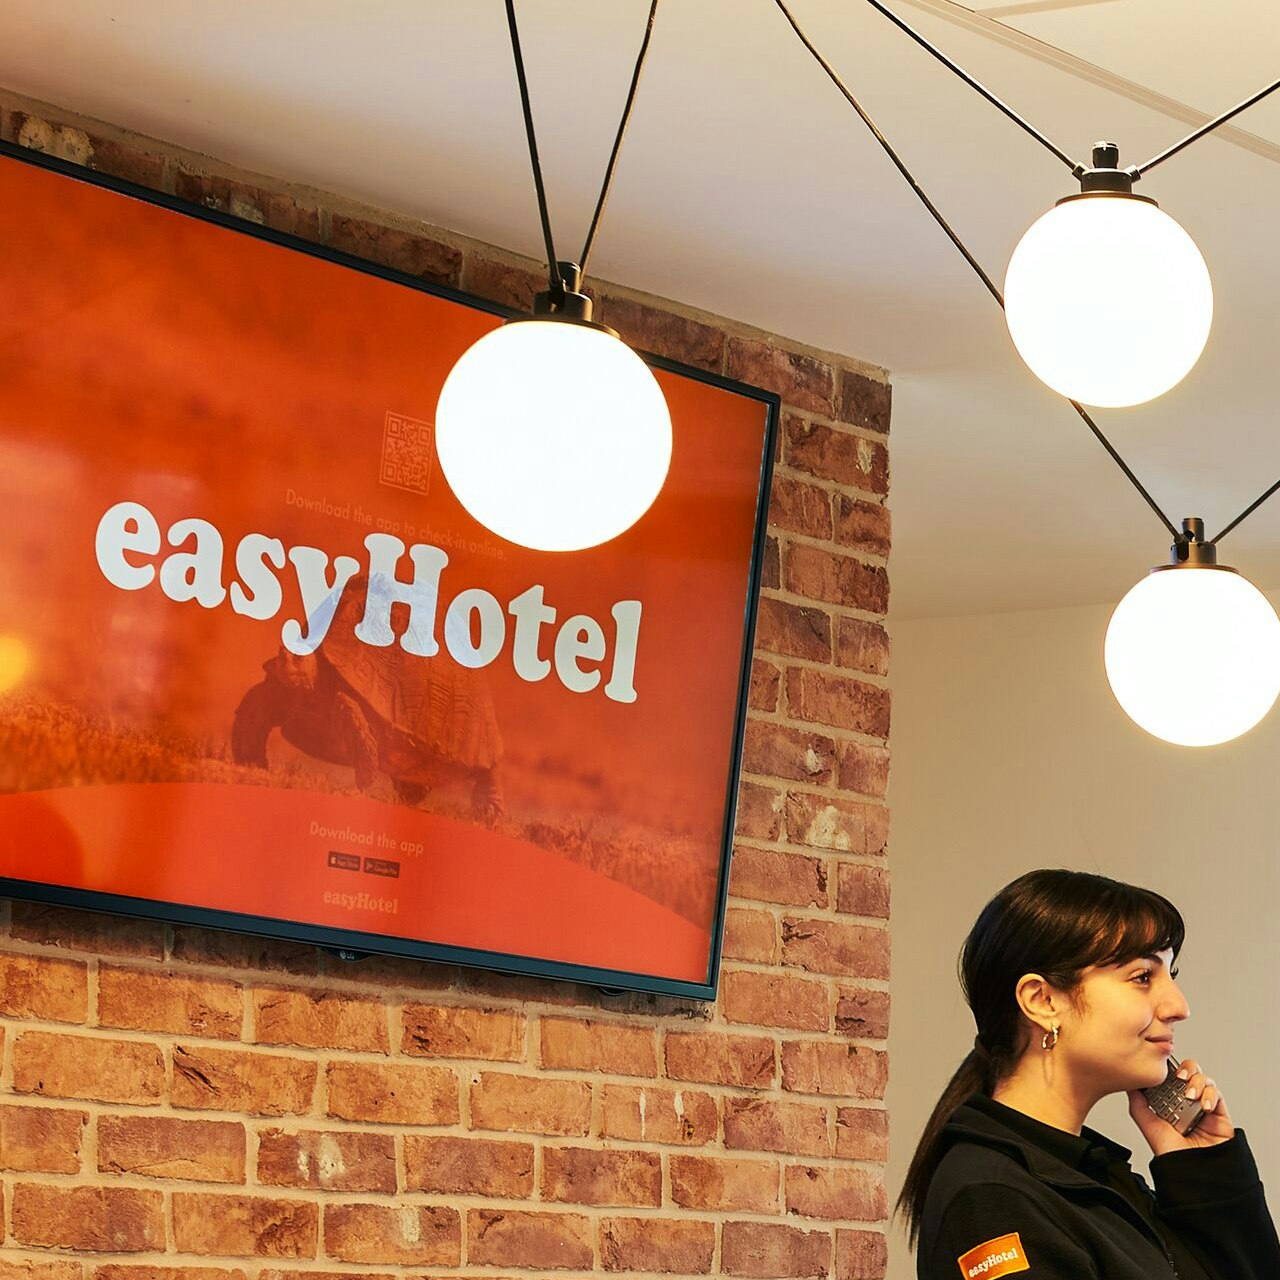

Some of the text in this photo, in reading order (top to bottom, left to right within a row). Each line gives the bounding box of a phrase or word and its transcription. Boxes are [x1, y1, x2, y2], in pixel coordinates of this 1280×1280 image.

[286, 488, 351, 521] Download
[353, 506, 373, 527] the
[376, 517, 401, 534] app
[403, 521, 416, 539] to
[95, 501, 643, 704] easyHotel
[310, 821, 424, 858] Download the app
[323, 890, 399, 914] easyHotel
[968, 1247, 1019, 1278] easyHotel
